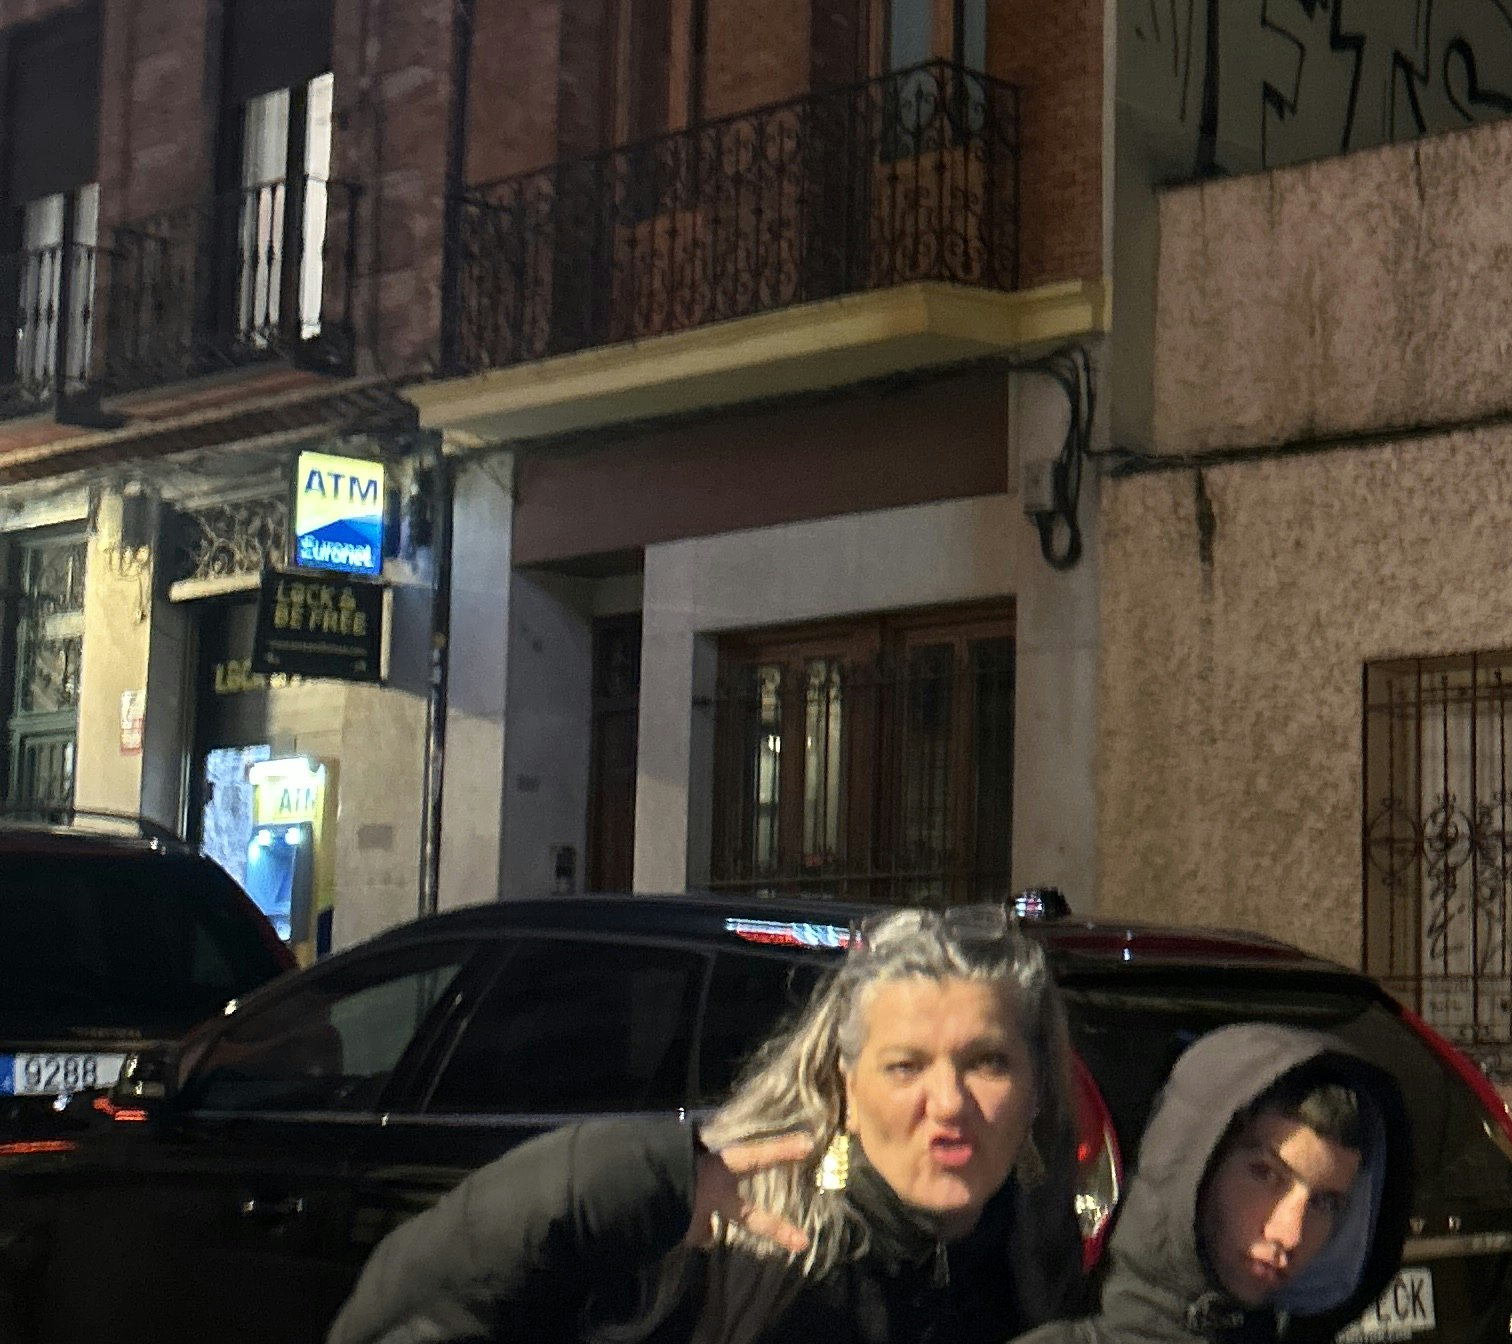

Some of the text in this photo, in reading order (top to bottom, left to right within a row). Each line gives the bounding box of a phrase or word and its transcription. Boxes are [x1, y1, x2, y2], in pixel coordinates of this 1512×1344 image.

[305, 469, 378, 505] ATM
[300, 535, 375, 568] Euronet
[25, 1058, 97, 1089] 9288
